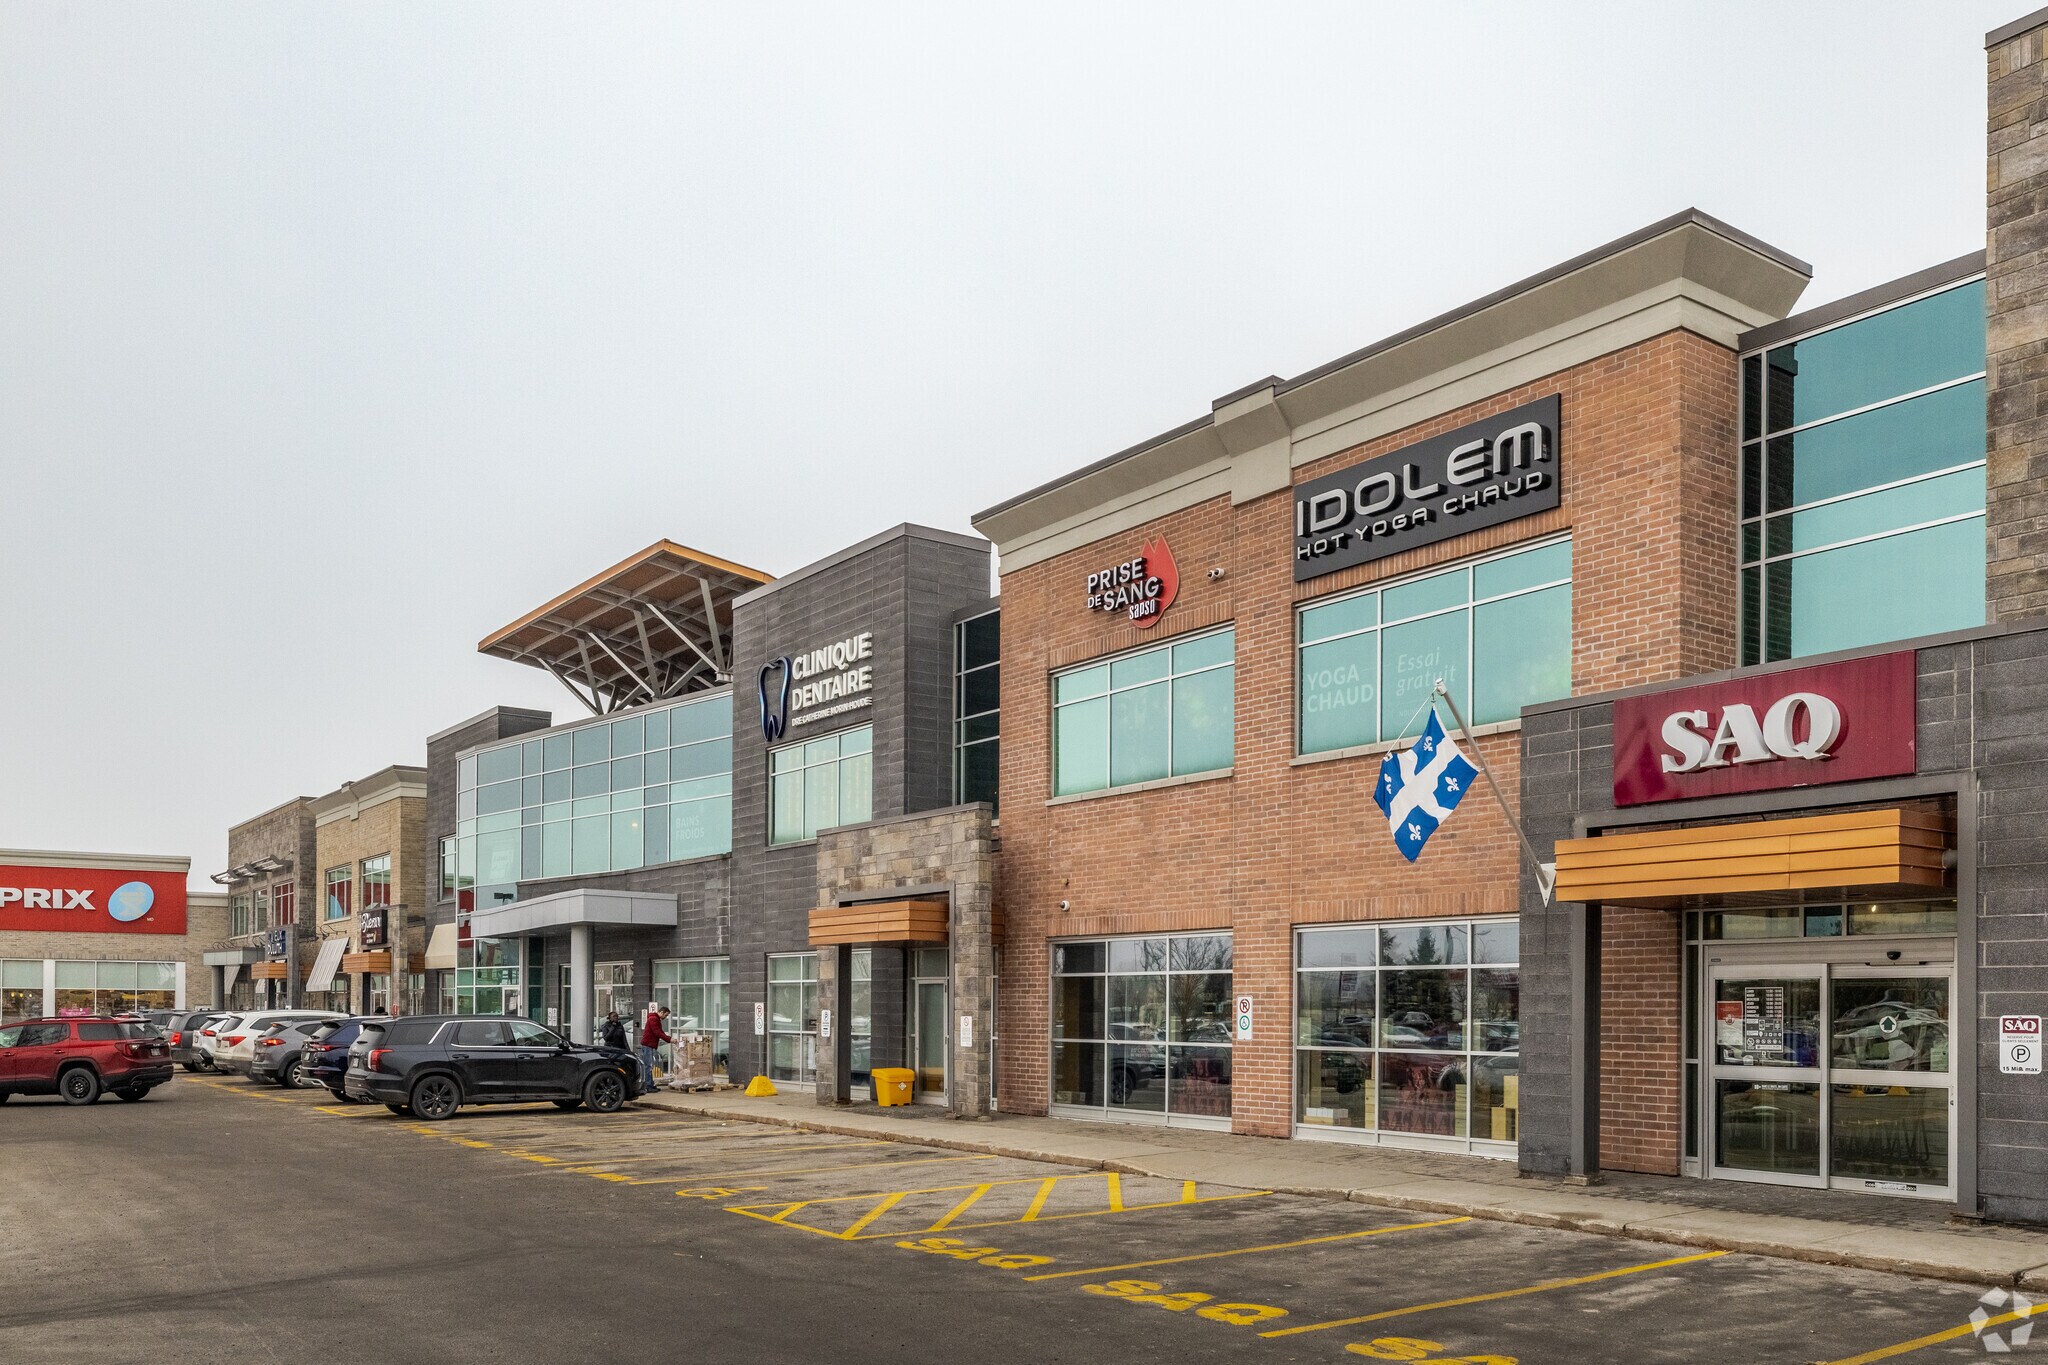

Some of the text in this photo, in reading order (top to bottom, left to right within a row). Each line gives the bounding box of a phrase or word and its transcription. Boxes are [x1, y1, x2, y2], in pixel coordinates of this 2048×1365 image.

[1297, 421, 1543, 537] IDOLEM
[1297, 471, 1543, 560] HOT YOGA CHAUD
[1087, 557, 1143, 594] PRISE
[1087, 576, 1160, 611] DE SANG
[1129, 598, 1156, 620] sapso
[792, 632, 873, 680] CLINIQUE
[1397, 647, 1441, 673] Essai
[792, 665, 873, 711] DENTAIRE
[1307, 663, 1360, 691] YOGA
[1306, 684, 1374, 713] CHAUD
[1661, 692, 1842, 774] SAQ
[0, 887, 97, 911] PRIX
[2005, 1020, 2037, 1032] SAQ
[894, 1237, 1057, 1270] SAQ
[1080, 1279, 1290, 1326] SAQ
